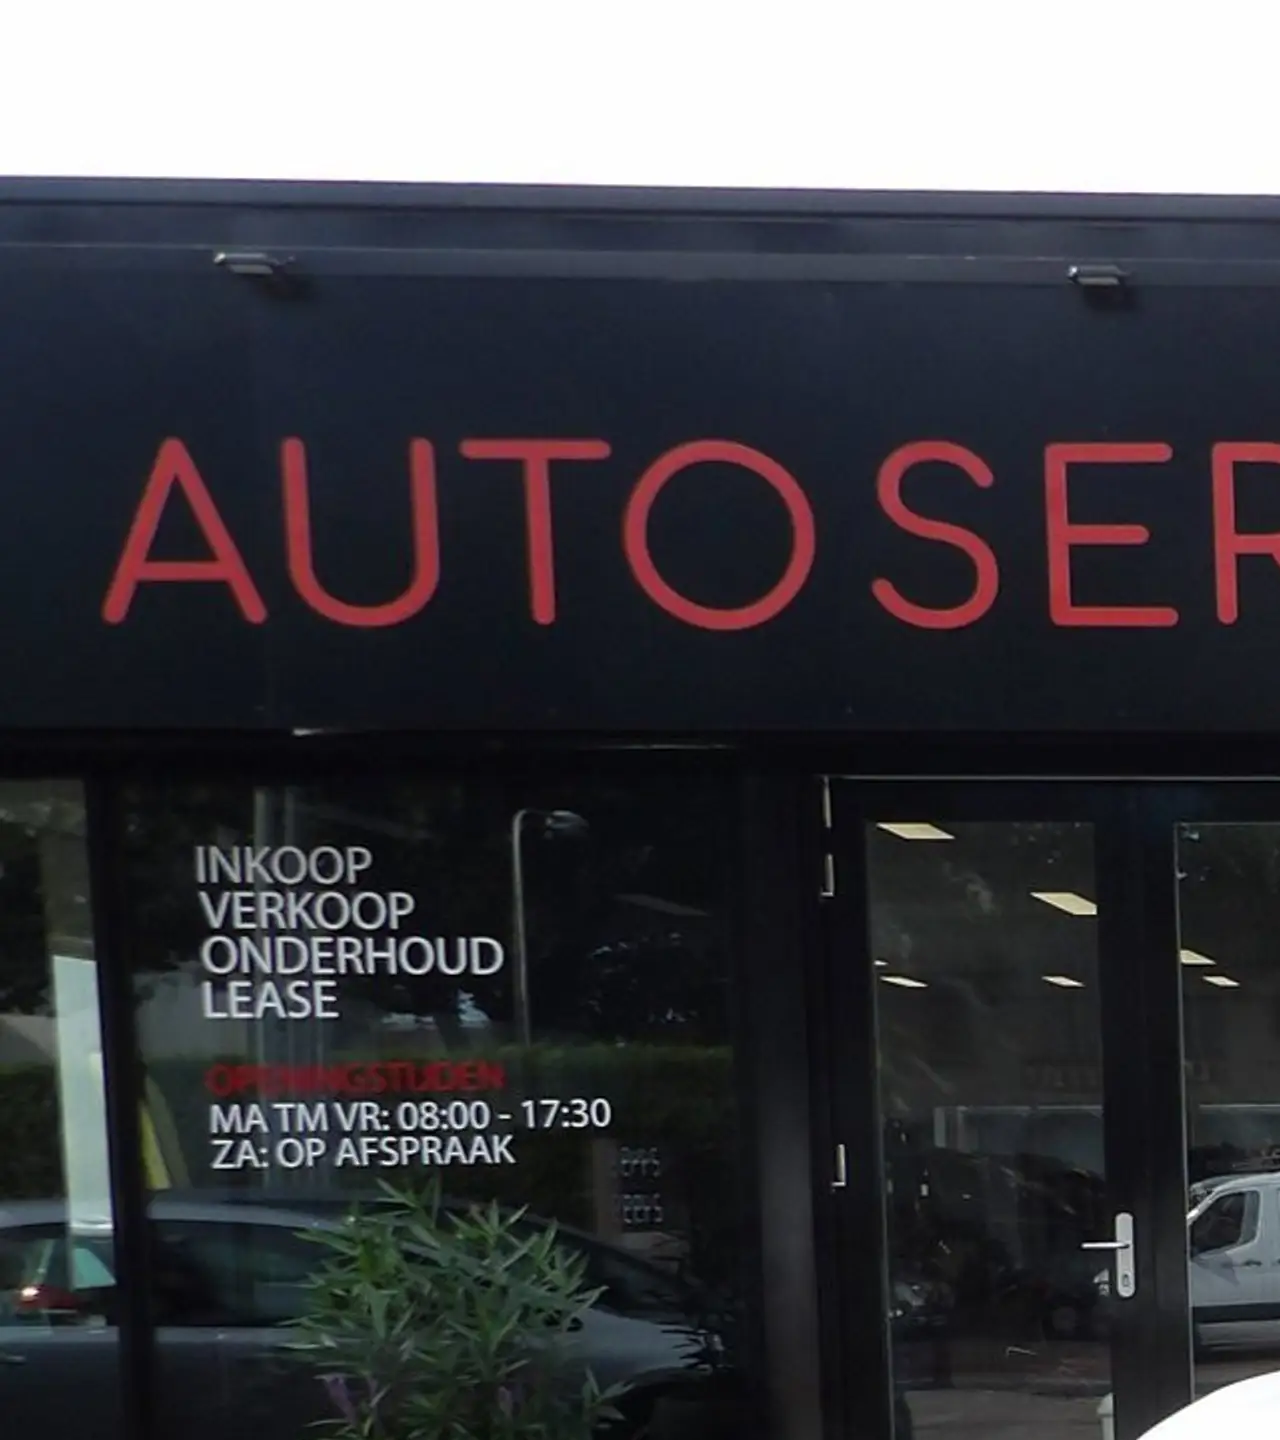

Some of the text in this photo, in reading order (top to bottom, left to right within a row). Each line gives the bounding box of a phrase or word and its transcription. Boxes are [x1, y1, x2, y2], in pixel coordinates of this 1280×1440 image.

[195, 845, 373, 885] INKOOP
[198, 890, 415, 930] VERKOOP
[201, 936, 505, 976] ONDERHOUD
[203, 980, 340, 1019] LEASE
[210, 1104, 268, 1134] MA
[272, 1103, 329, 1133] TM
[334, 1102, 391, 1132] VR:
[398, 1100, 492, 1131] 08:00
[521, 1099, 613, 1128] 17:30
[211, 1134, 517, 1170] ZA: OP AFSPRAAK
